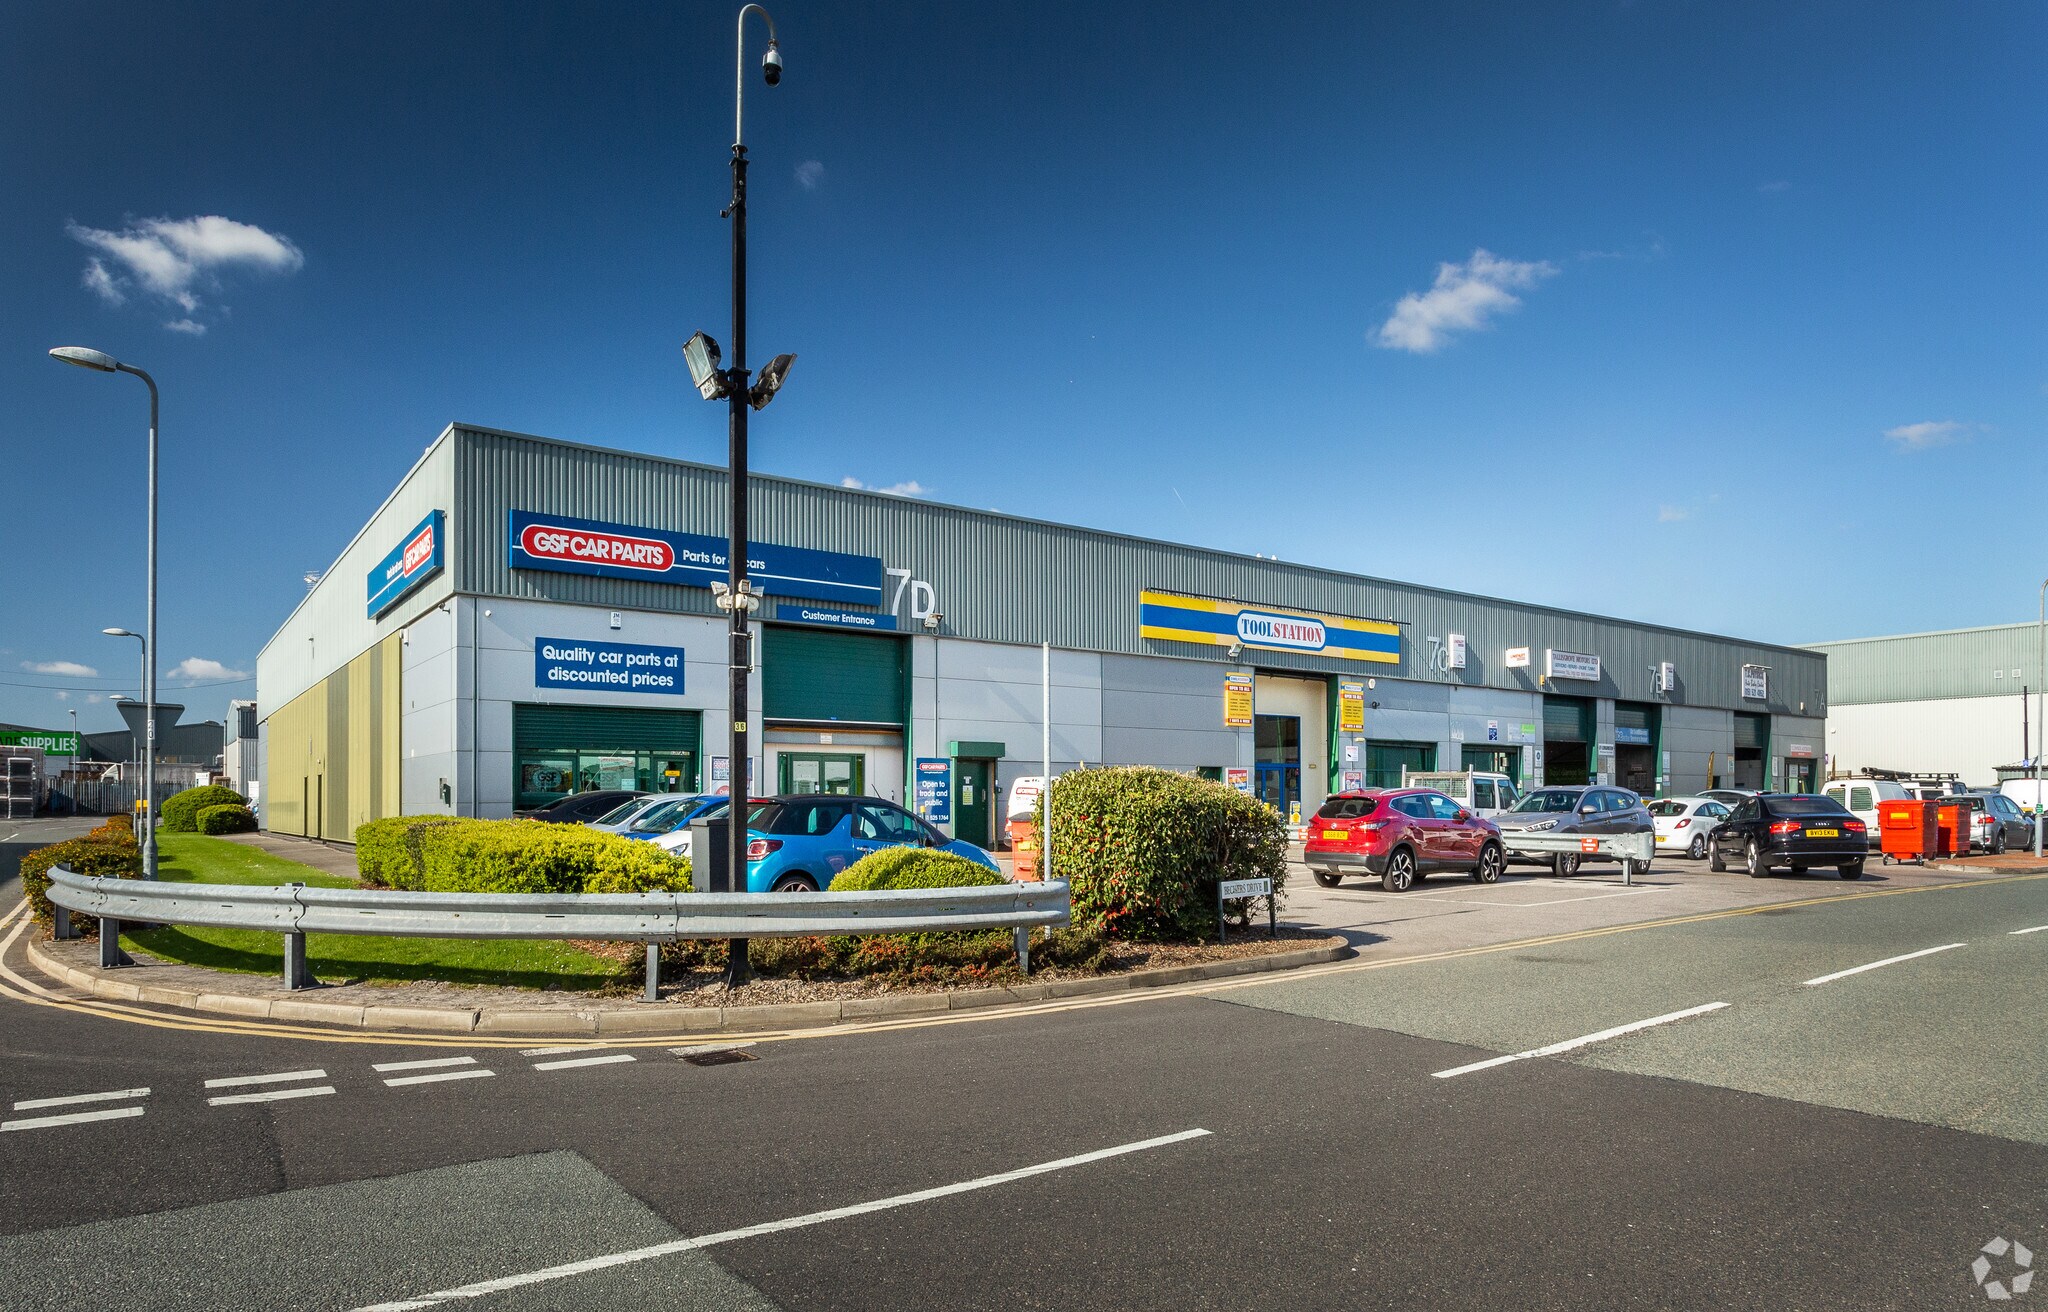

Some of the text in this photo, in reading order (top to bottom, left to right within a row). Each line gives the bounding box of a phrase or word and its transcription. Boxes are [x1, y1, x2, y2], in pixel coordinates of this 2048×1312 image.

[533, 532, 664, 565] GSF CAR PARTS
[683, 549, 710, 564] Parts
[711, 553, 726, 566] for
[886, 567, 936, 619] 7D
[802, 610, 875, 625] Customer Entrance
[1241, 618, 1322, 643] TOOLSTATION
[542, 645, 678, 668] Quality car parts at
[548, 667, 674, 688] discounted prices
[1647, 665, 1663, 694] 7B
[736, 722, 745, 731] 36
[20, 736, 78, 751] SUPPLIES
[921, 780, 946, 788] Open to
